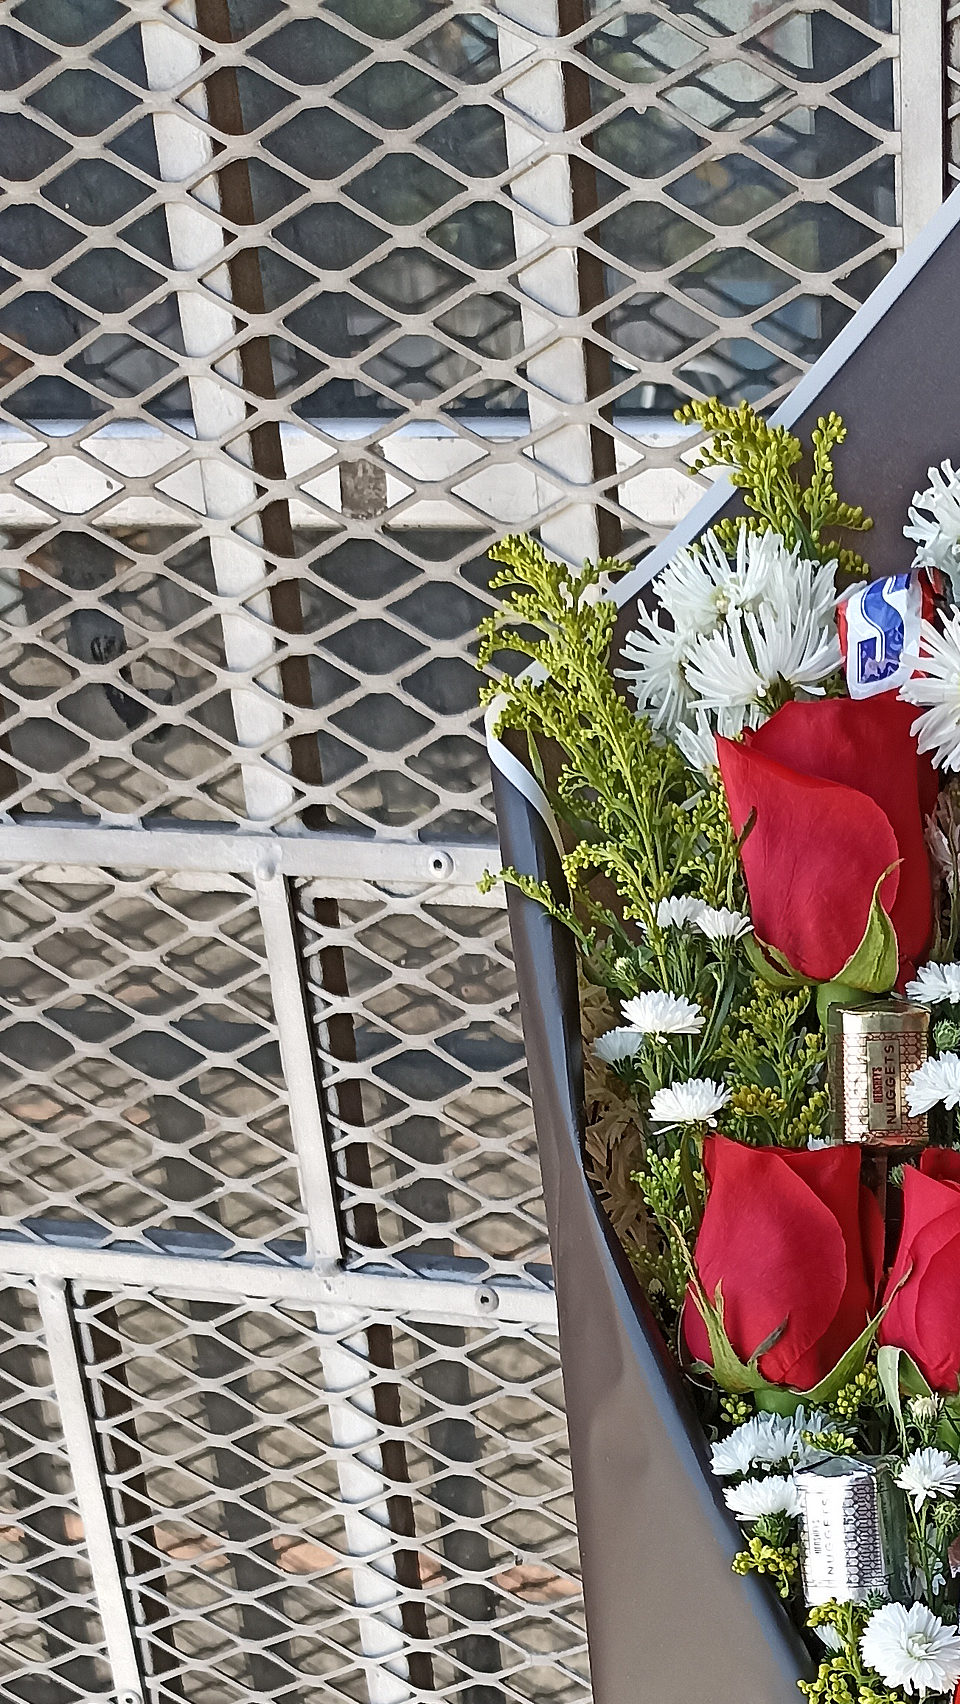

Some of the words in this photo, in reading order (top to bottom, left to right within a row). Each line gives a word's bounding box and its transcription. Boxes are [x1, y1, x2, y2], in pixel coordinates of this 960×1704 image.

[857, 573, 912, 684] S
[884, 1044, 897, 1125] NUGGETS
[822, 1499, 835, 1575] NUGGETS
